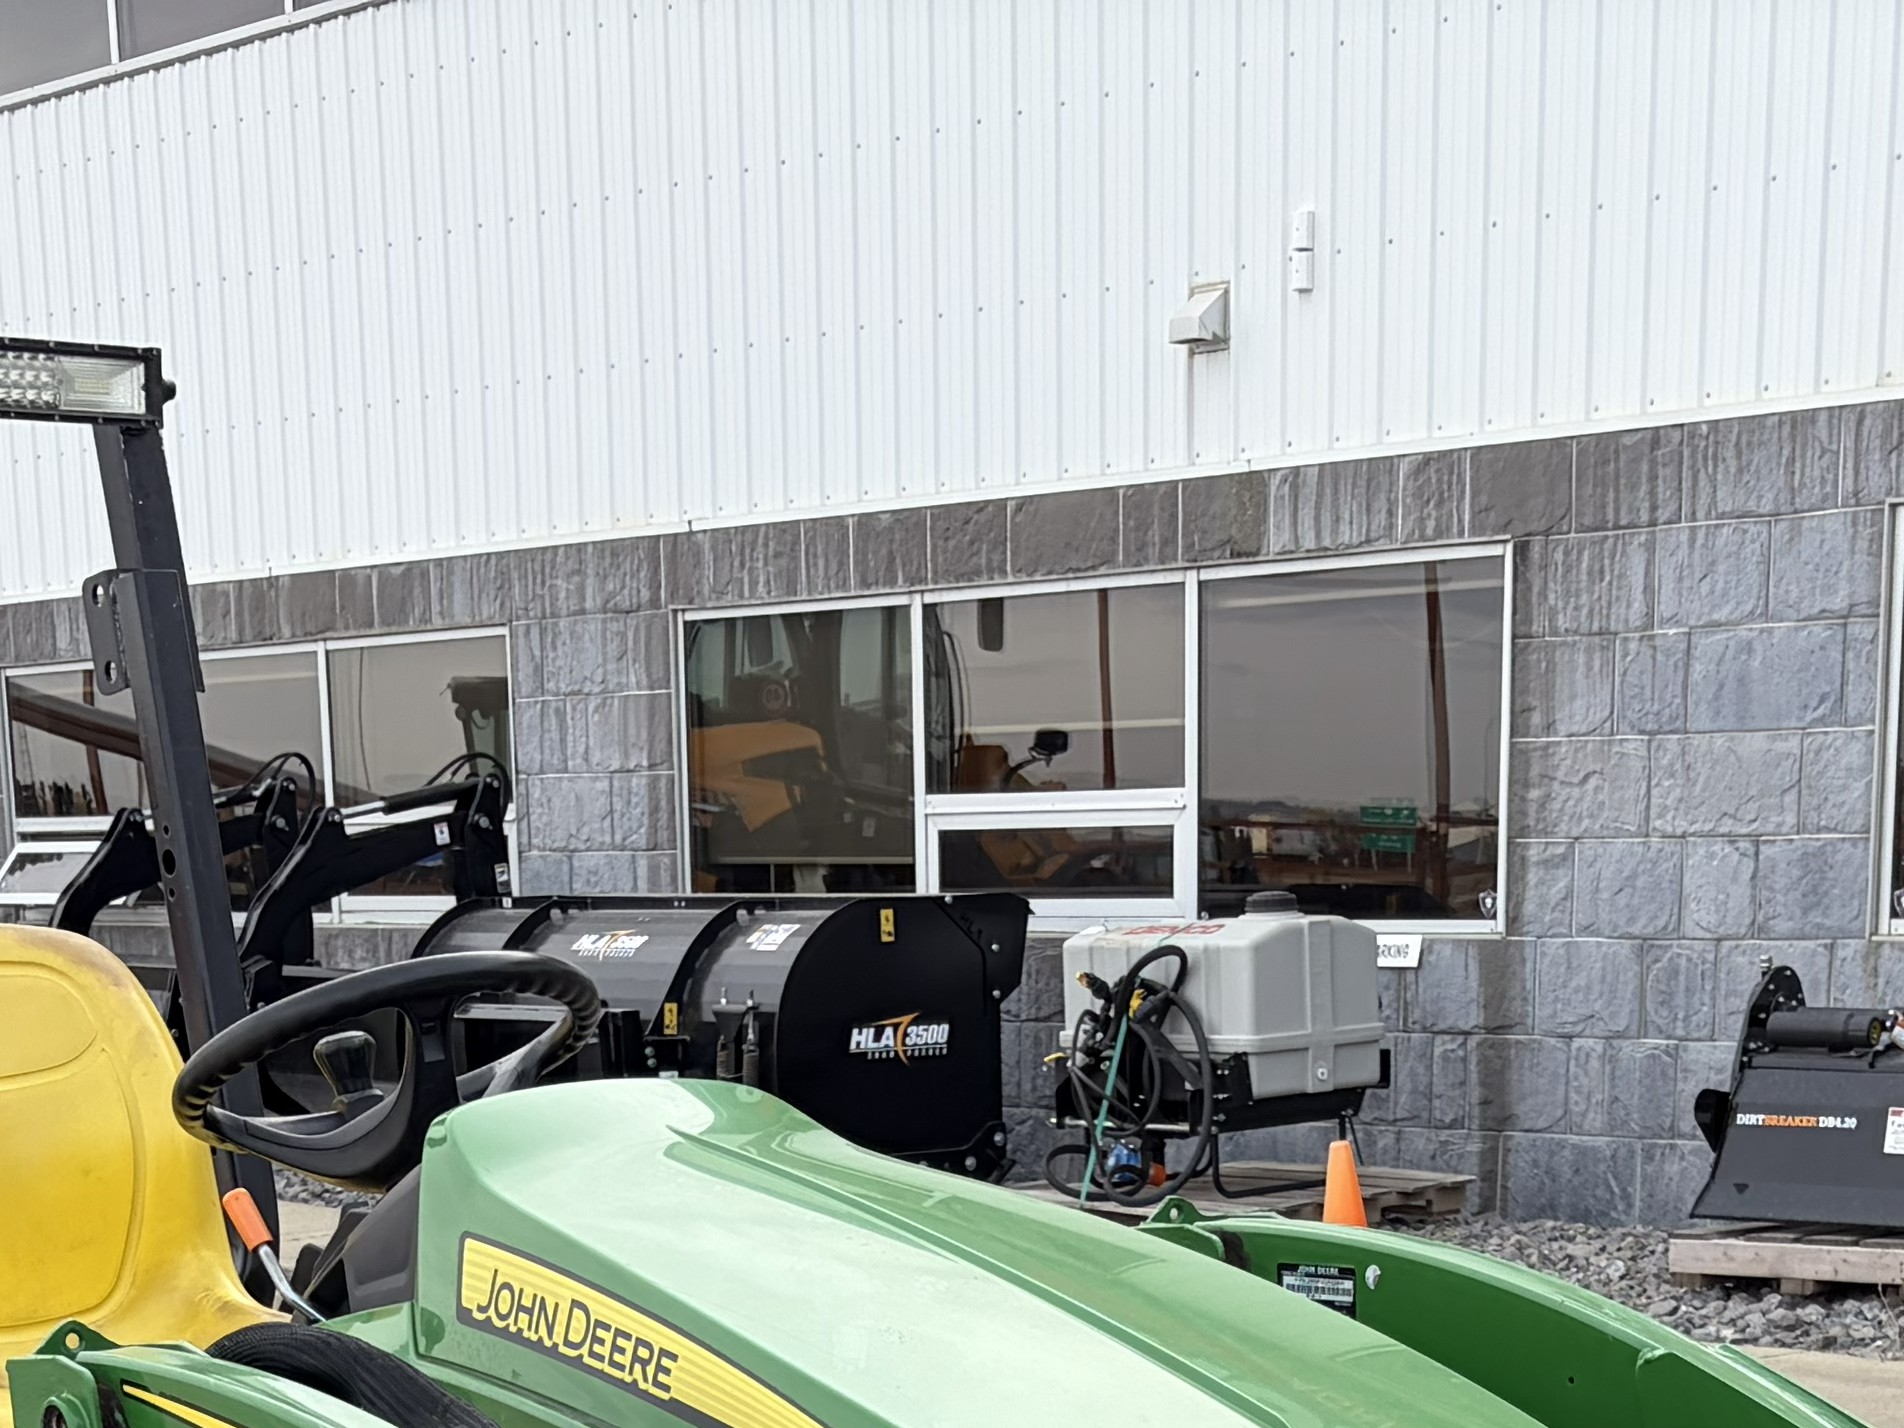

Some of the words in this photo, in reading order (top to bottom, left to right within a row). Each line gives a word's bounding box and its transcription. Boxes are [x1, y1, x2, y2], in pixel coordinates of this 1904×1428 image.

[849, 1027, 895, 1051] HLA
[905, 1023, 950, 1046] 3500
[475, 1268, 559, 1342] JOHN
[562, 1298, 679, 1395] DEERE
